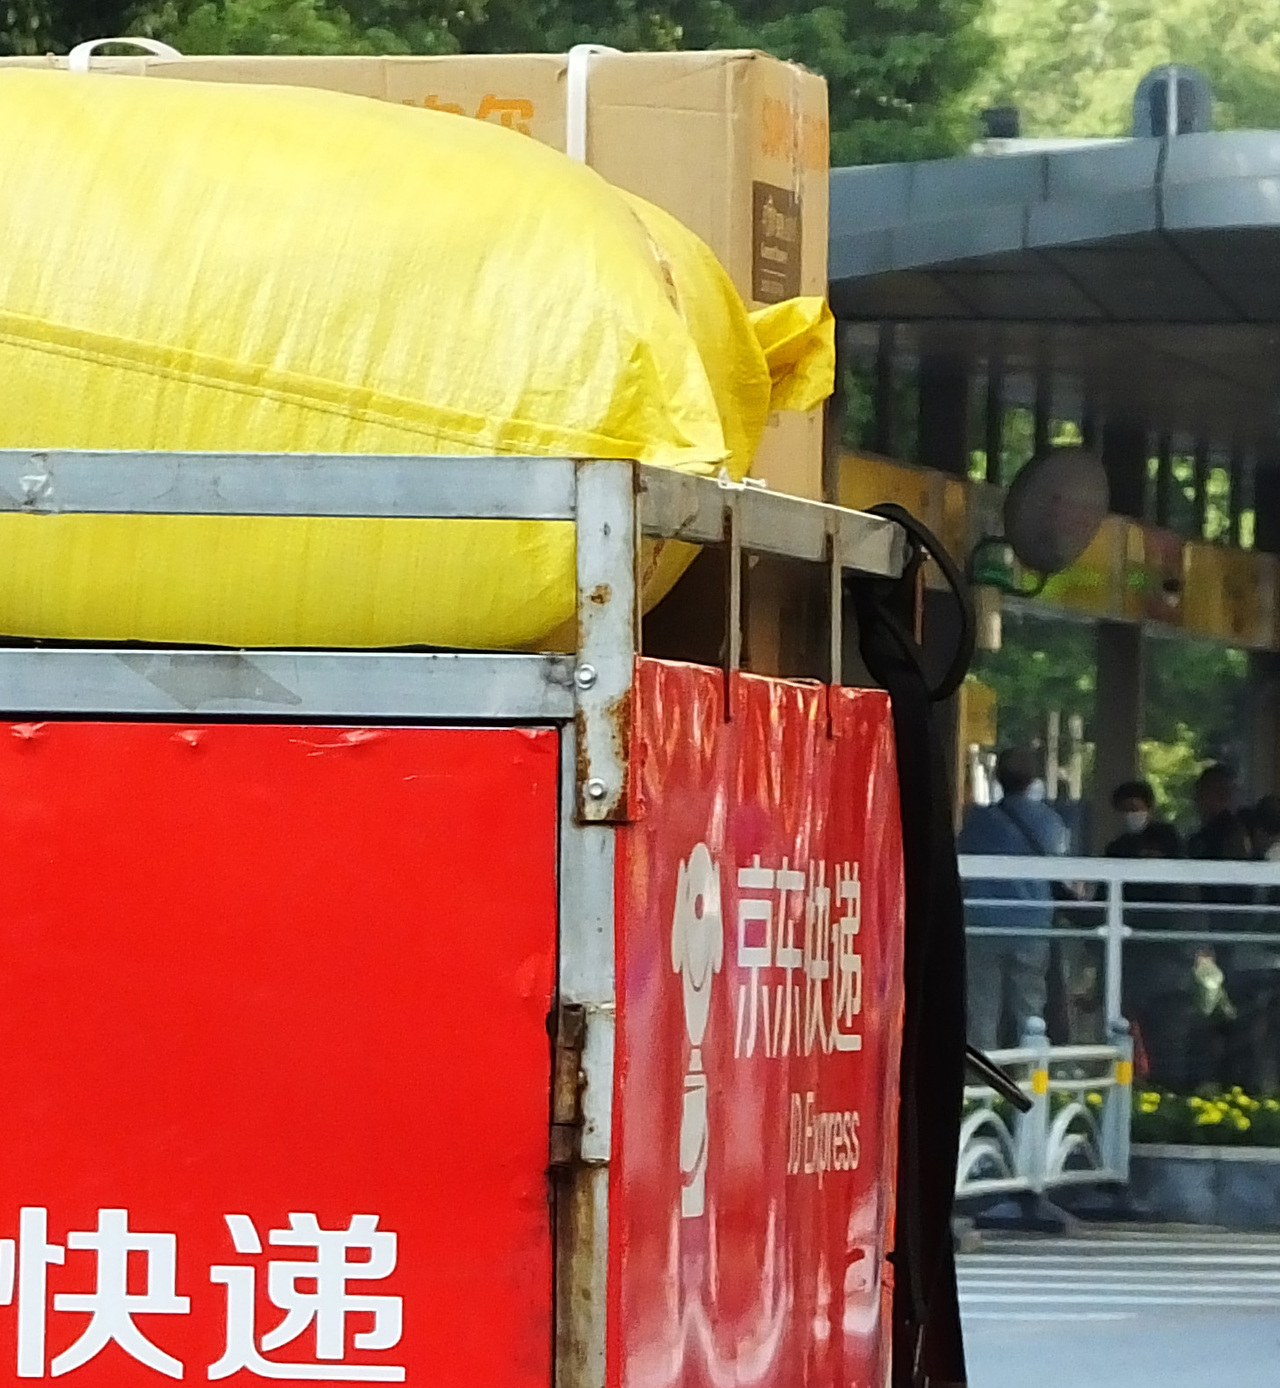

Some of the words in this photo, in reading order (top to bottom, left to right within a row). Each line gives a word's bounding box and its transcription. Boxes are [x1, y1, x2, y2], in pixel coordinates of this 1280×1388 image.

[734, 854, 862, 1060] 京东快递
[804, 1090, 861, 1190] Express
